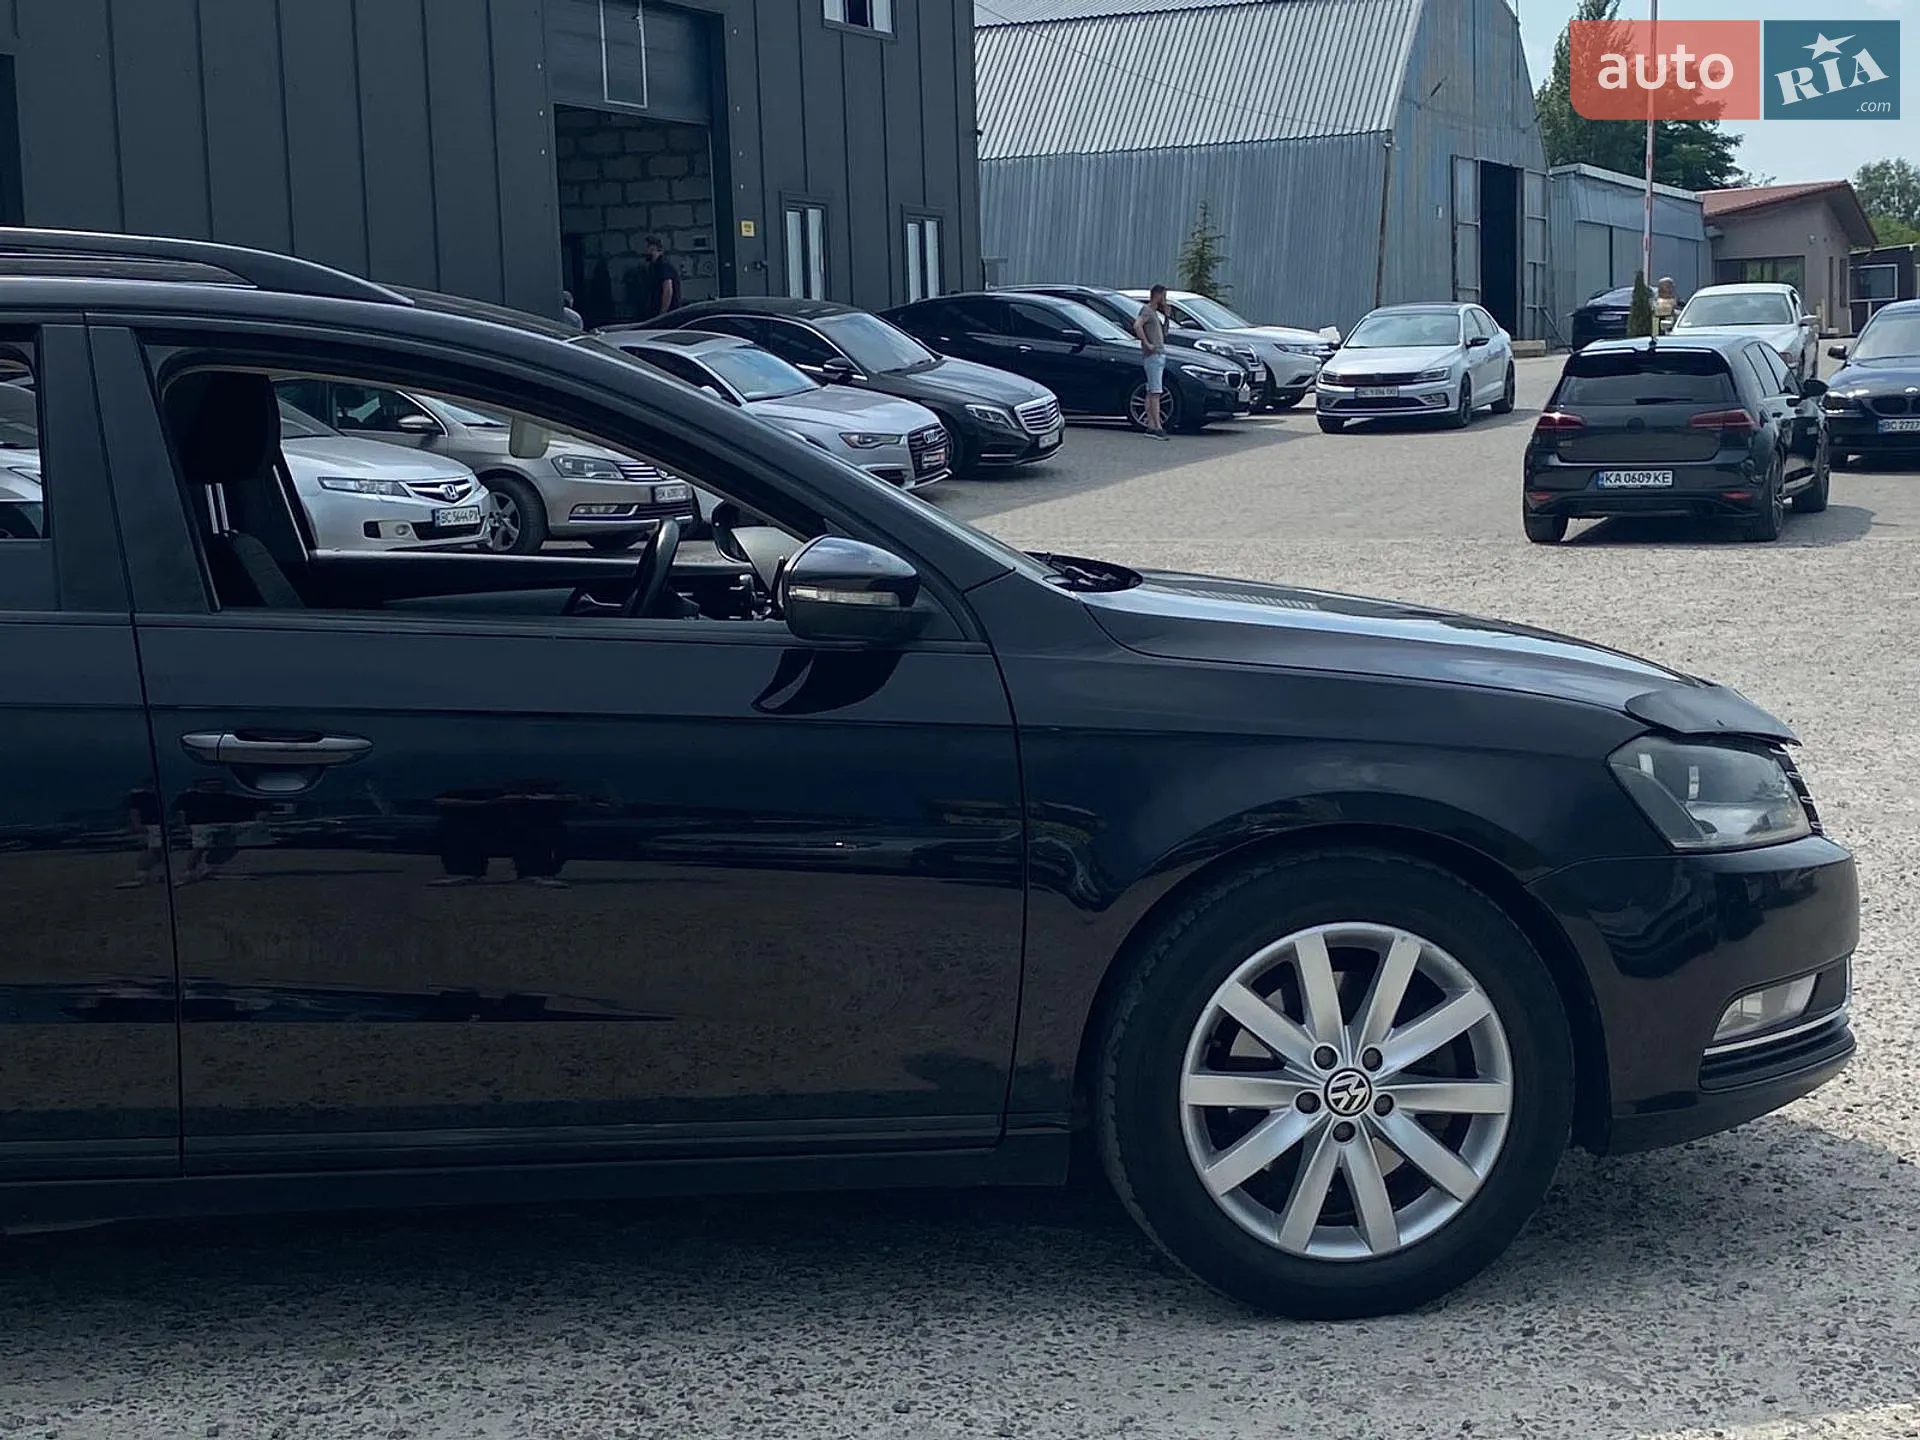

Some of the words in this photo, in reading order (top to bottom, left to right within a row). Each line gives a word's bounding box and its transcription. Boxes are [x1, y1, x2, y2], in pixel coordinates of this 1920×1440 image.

[1605, 472, 1622, 484] KA
[1624, 472, 1652, 484] 0609
[1653, 472, 1671, 484] KE
